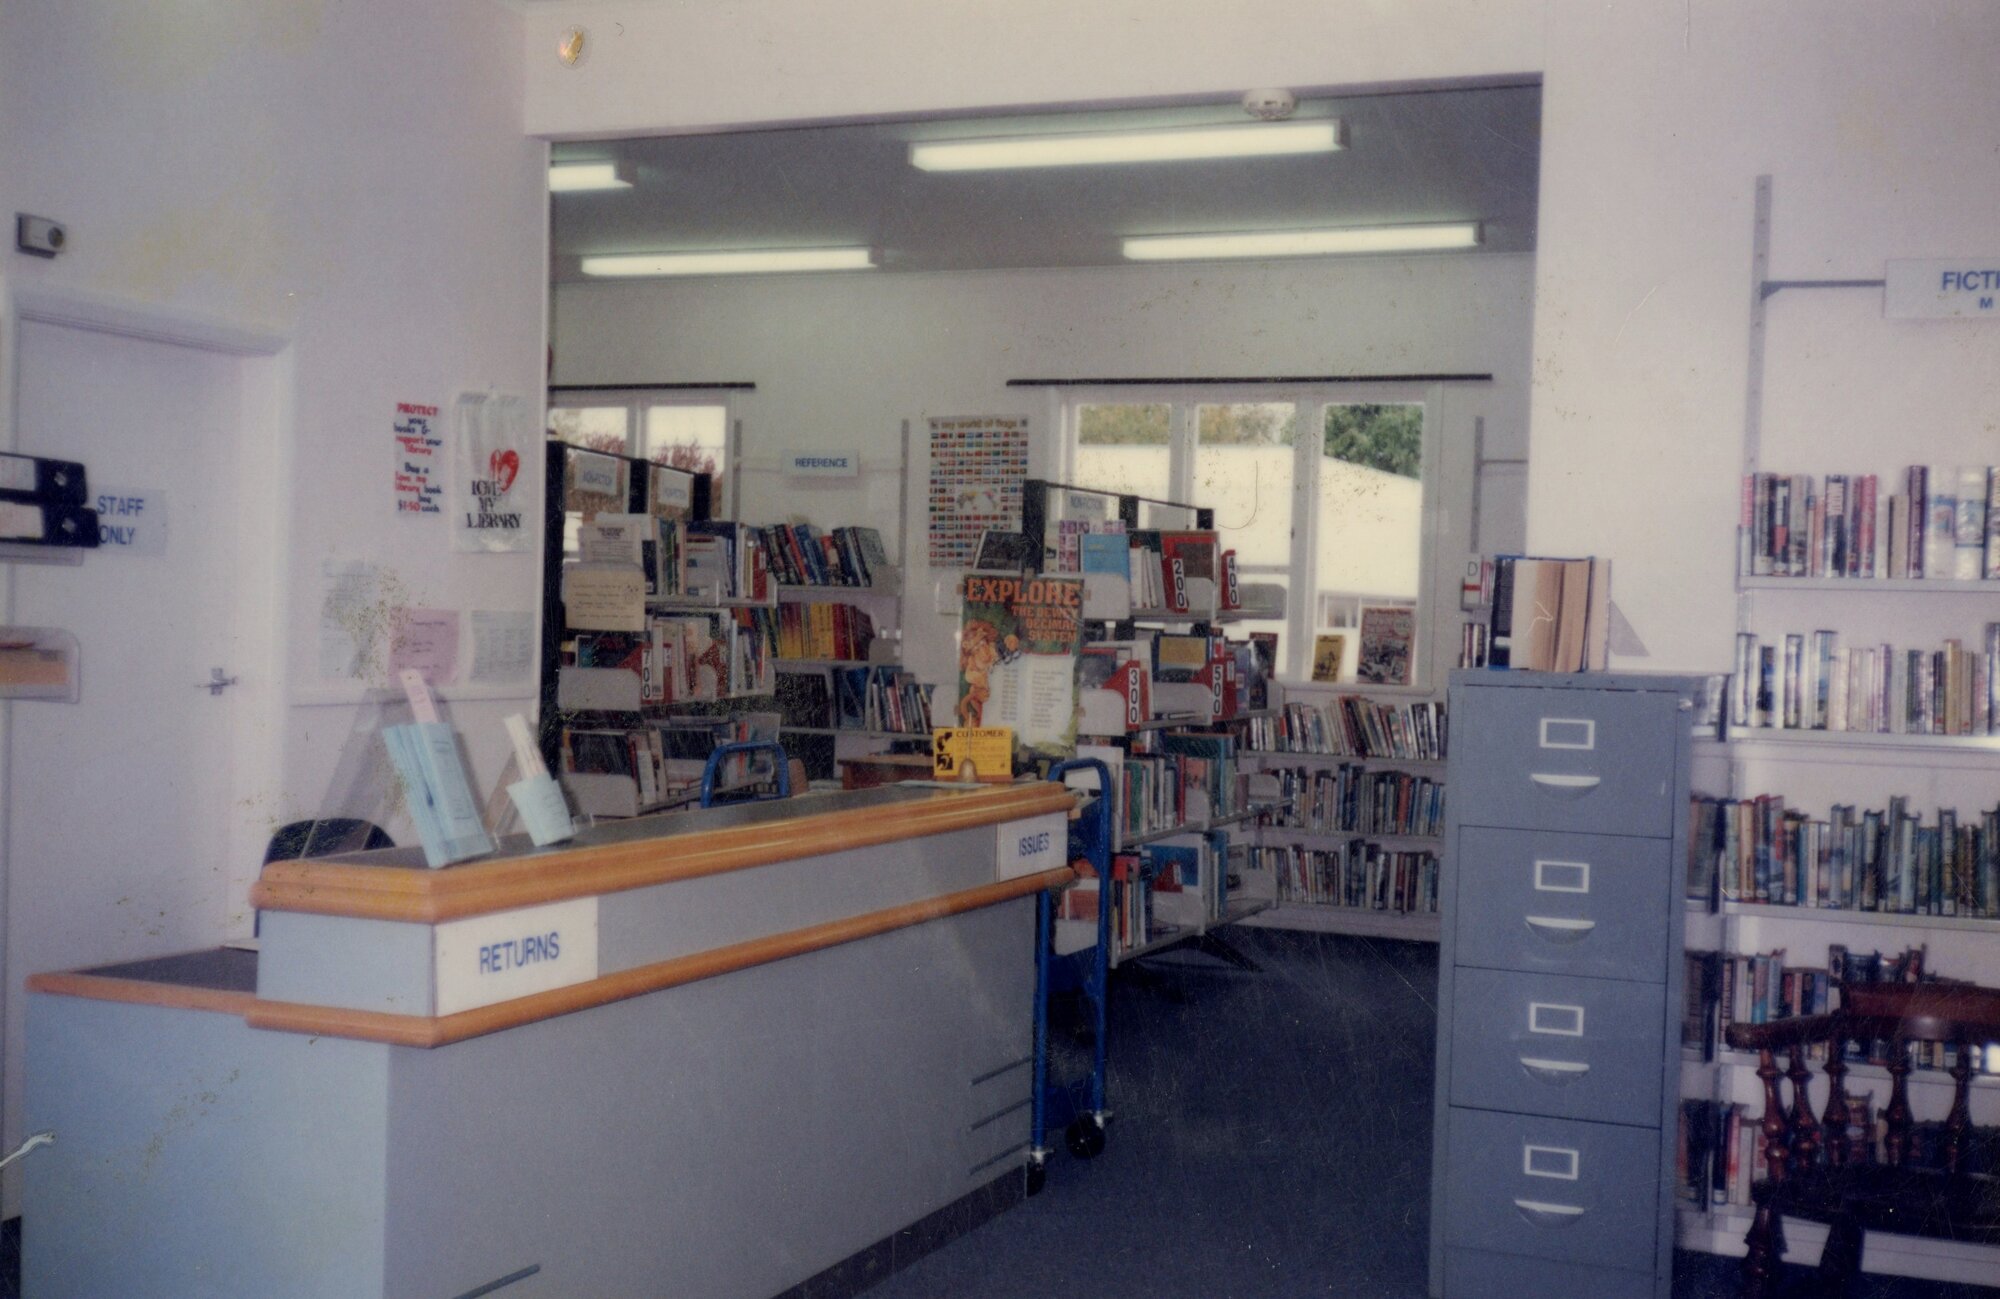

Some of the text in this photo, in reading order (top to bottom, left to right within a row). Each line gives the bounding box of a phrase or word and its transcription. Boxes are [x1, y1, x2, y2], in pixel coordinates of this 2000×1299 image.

[397, 402, 439, 416] PROTECT
[795, 458, 848, 468] REFERENCE
[97, 495, 145, 517] STAFF
[466, 513, 522, 529] LIBRARY
[98, 525, 135, 545] ONLY
[1173, 560, 1186, 607] 200
[1227, 556, 1238, 604] 400
[966, 578, 1081, 606] EXPLORE
[1011, 605, 1035, 617] THE
[1028, 630, 1078, 642] SYSTEM
[1130, 669, 1138, 723] 300
[1213, 666, 1222, 714] 500
[1019, 832, 1050, 856] ISSUES
[479, 931, 560, 975] RETURNS
